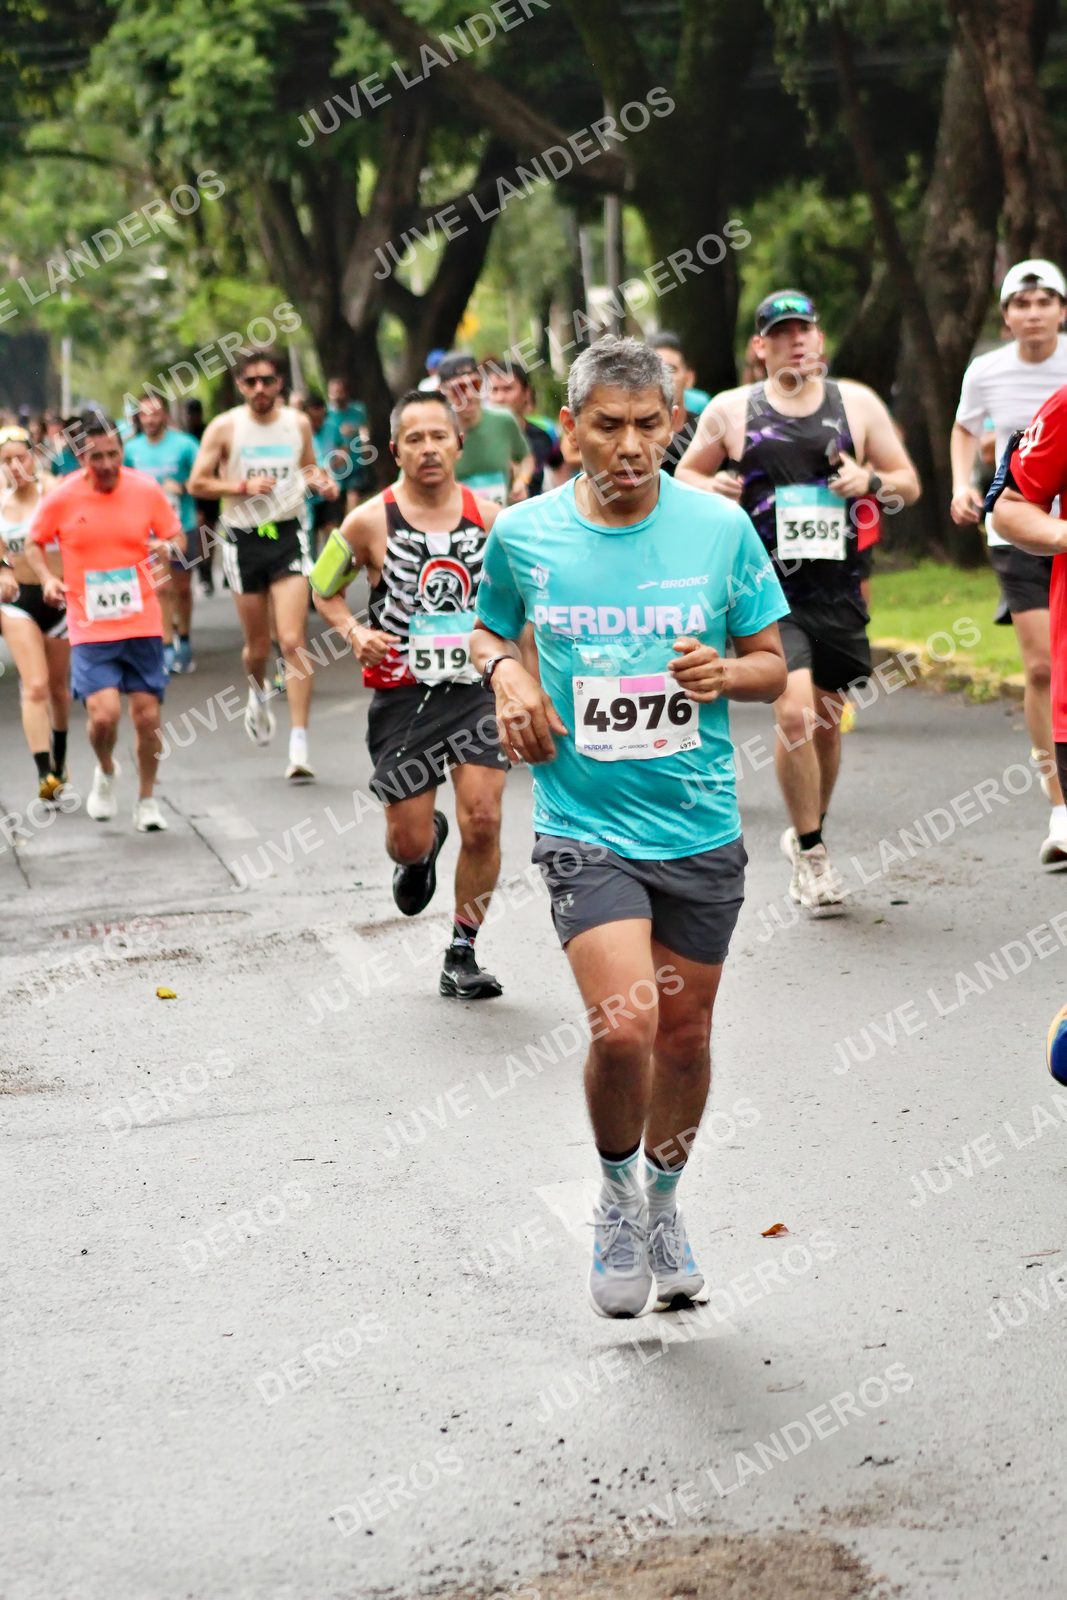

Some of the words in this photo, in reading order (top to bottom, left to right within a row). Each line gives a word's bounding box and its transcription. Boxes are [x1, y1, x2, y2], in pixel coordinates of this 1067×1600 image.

[660, 575, 709, 588] BROOKS
[533, 604, 707, 634] PERDURA
[583, 691, 693, 732] 4976
